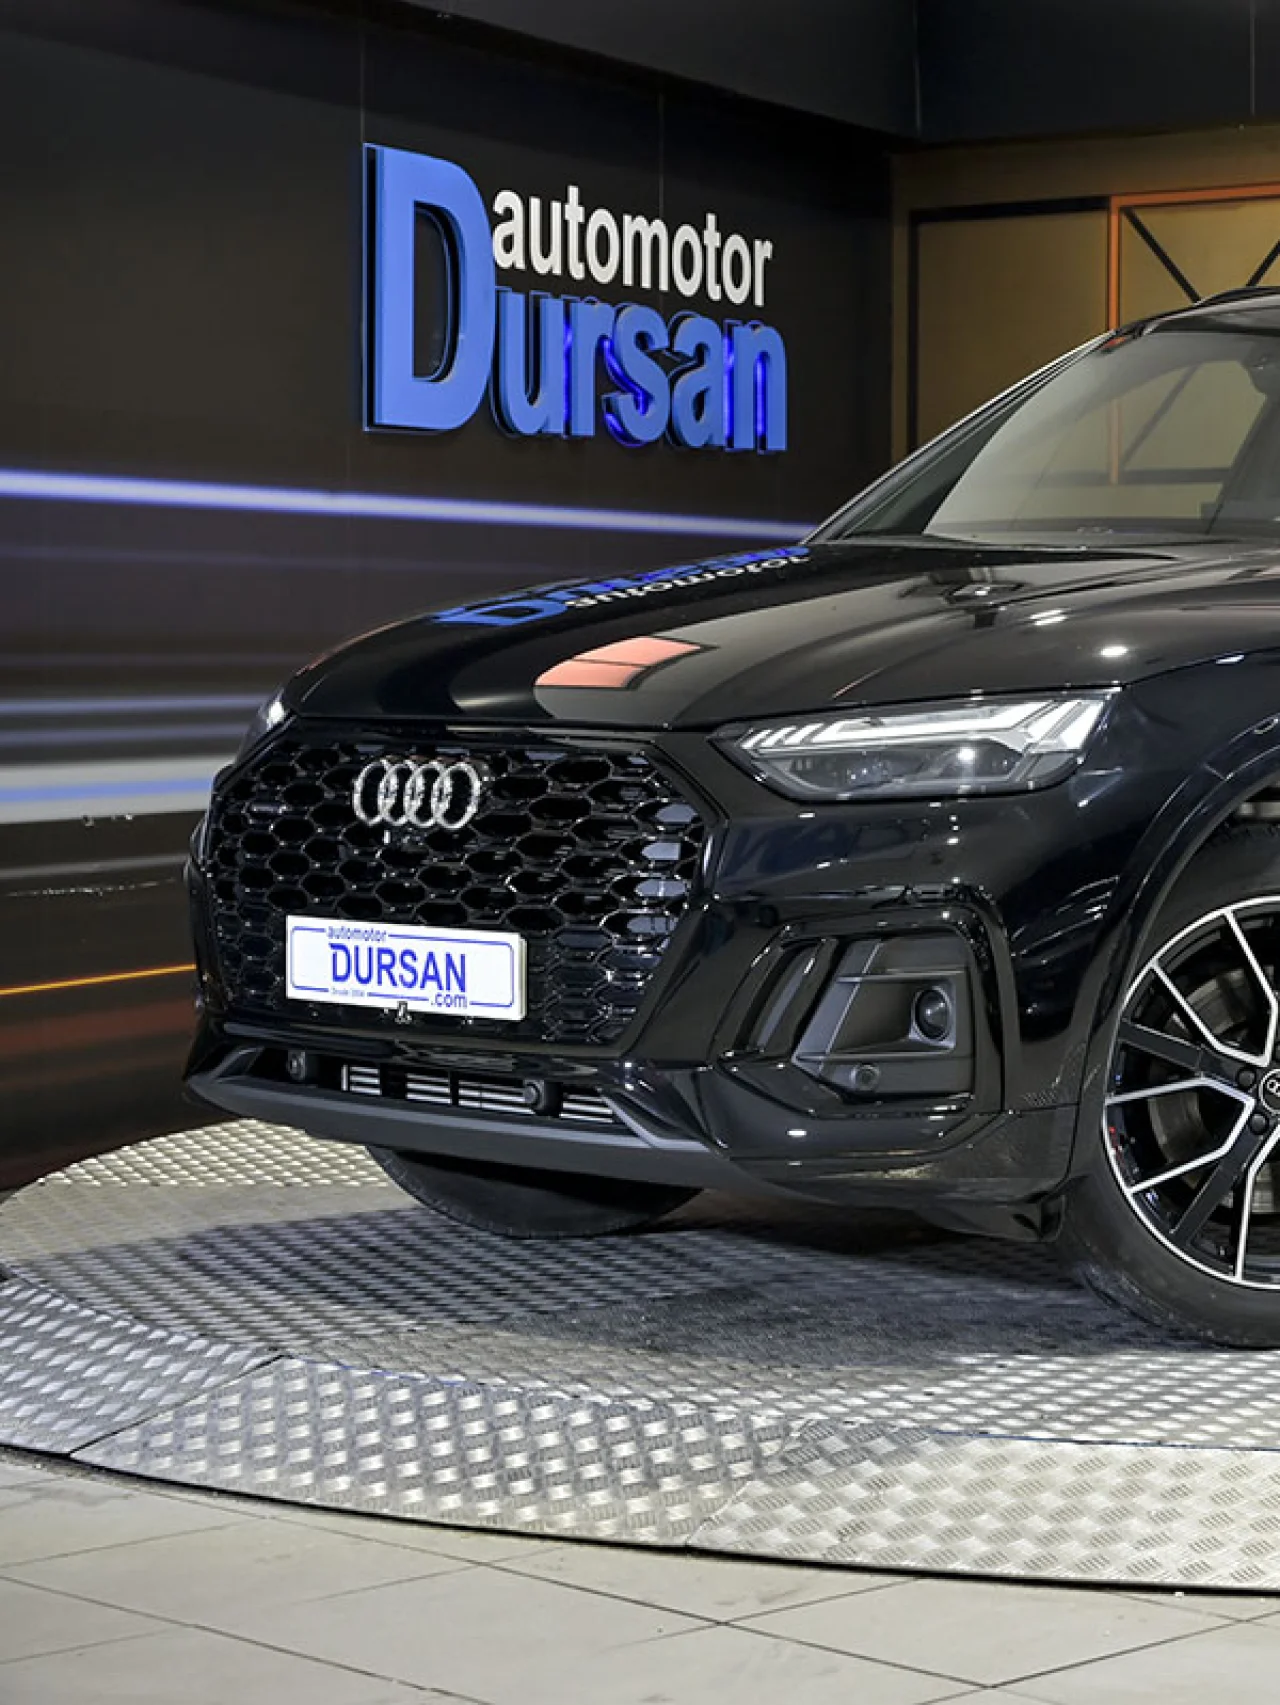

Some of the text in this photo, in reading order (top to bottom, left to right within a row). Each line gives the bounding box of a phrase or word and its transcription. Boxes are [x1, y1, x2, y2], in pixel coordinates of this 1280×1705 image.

[492, 185, 773, 307] automotor
[363, 142, 788, 453] Dursan
[327, 926, 387, 942] automotor
[329, 943, 466, 992] DURSAN
[431, 993, 467, 1008] .com
